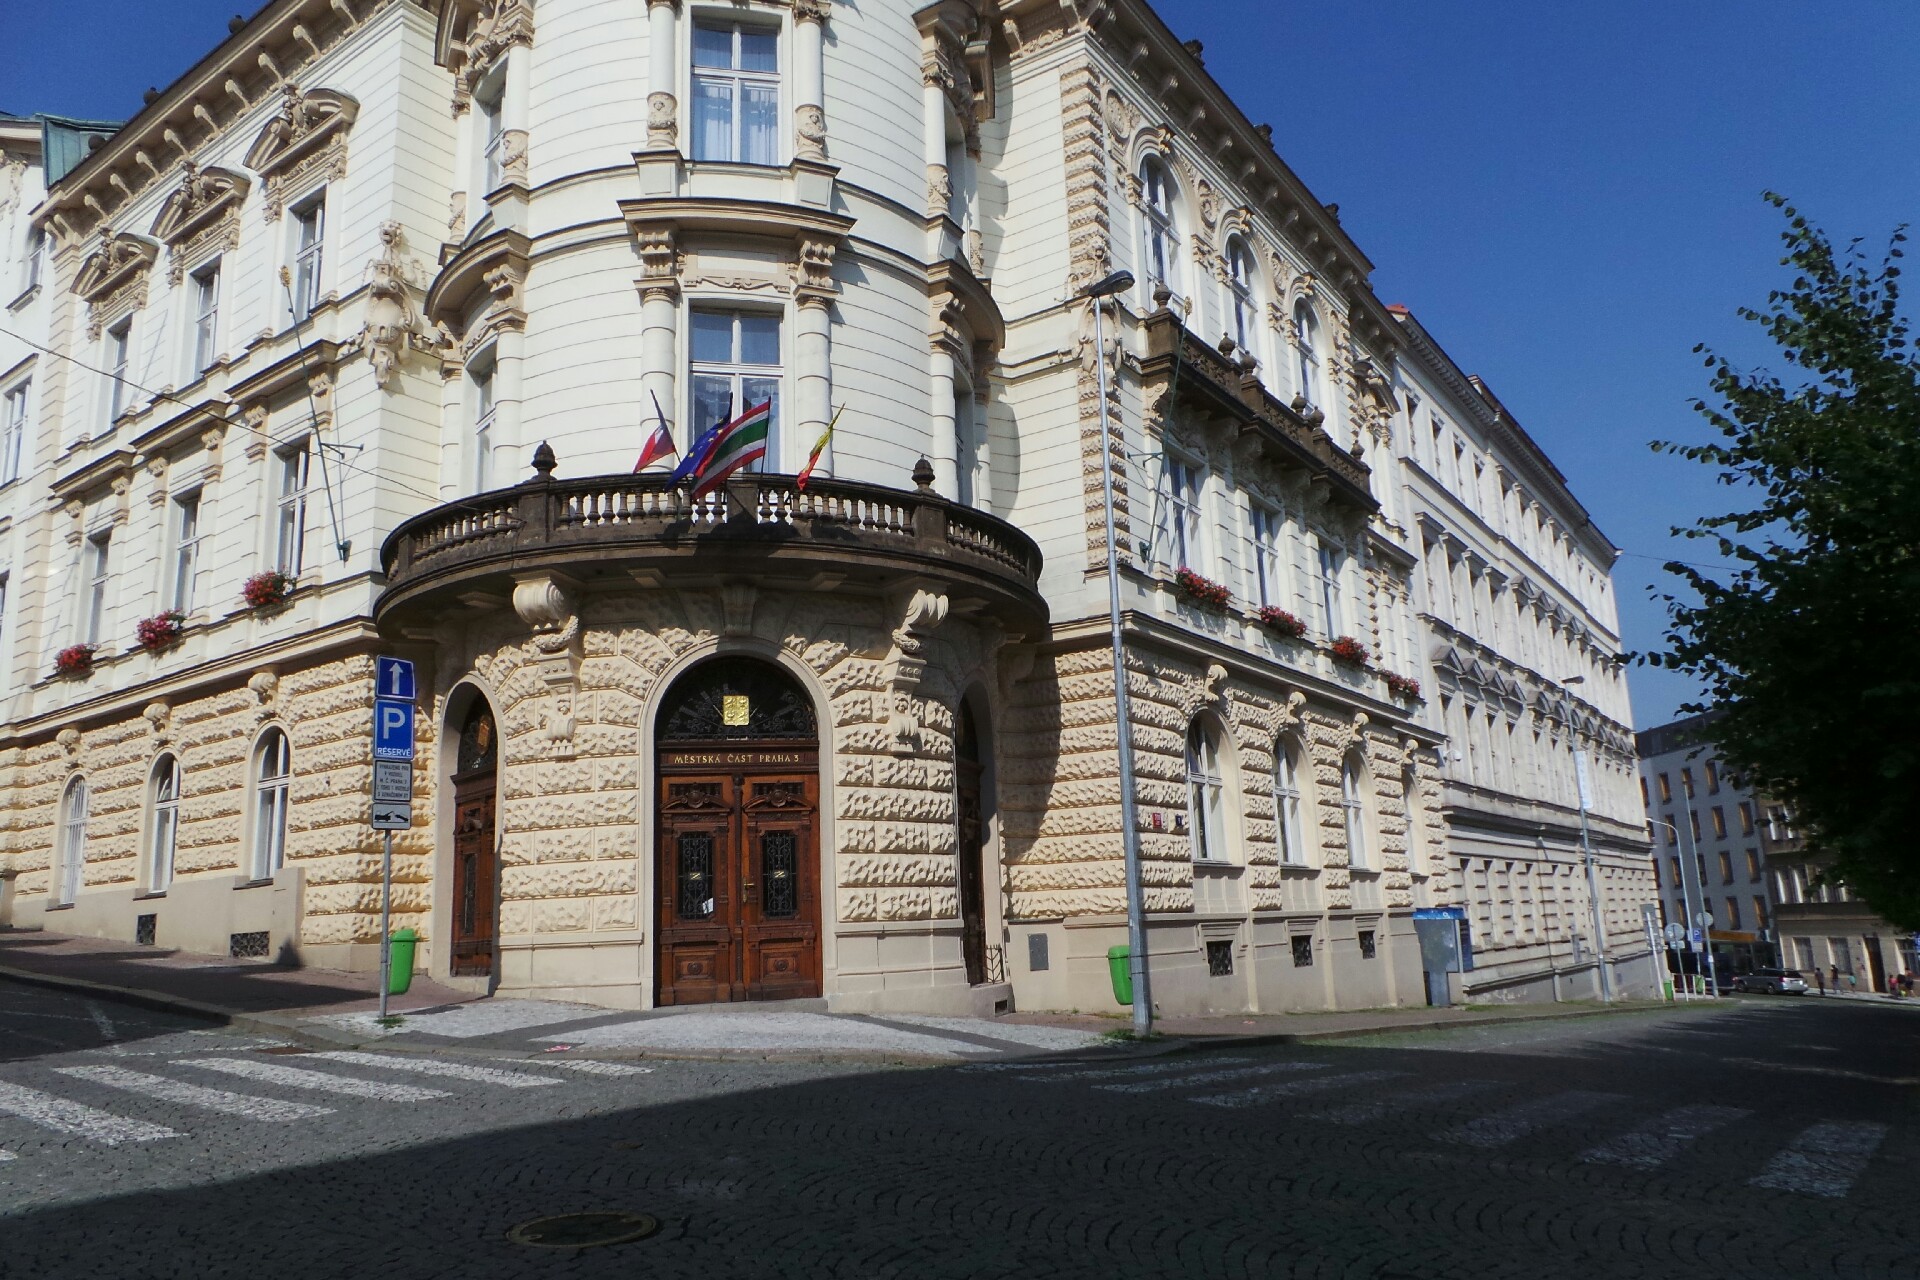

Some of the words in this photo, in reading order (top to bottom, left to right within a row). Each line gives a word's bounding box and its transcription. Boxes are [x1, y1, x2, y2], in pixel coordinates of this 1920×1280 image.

[383, 707, 406, 740] P
[674, 754, 721, 764] MĚSTSKÁ
[727, 753, 753, 764] ČÁST
[759, 754, 791, 763] PRAHA
[793, 754, 799, 763] 3
